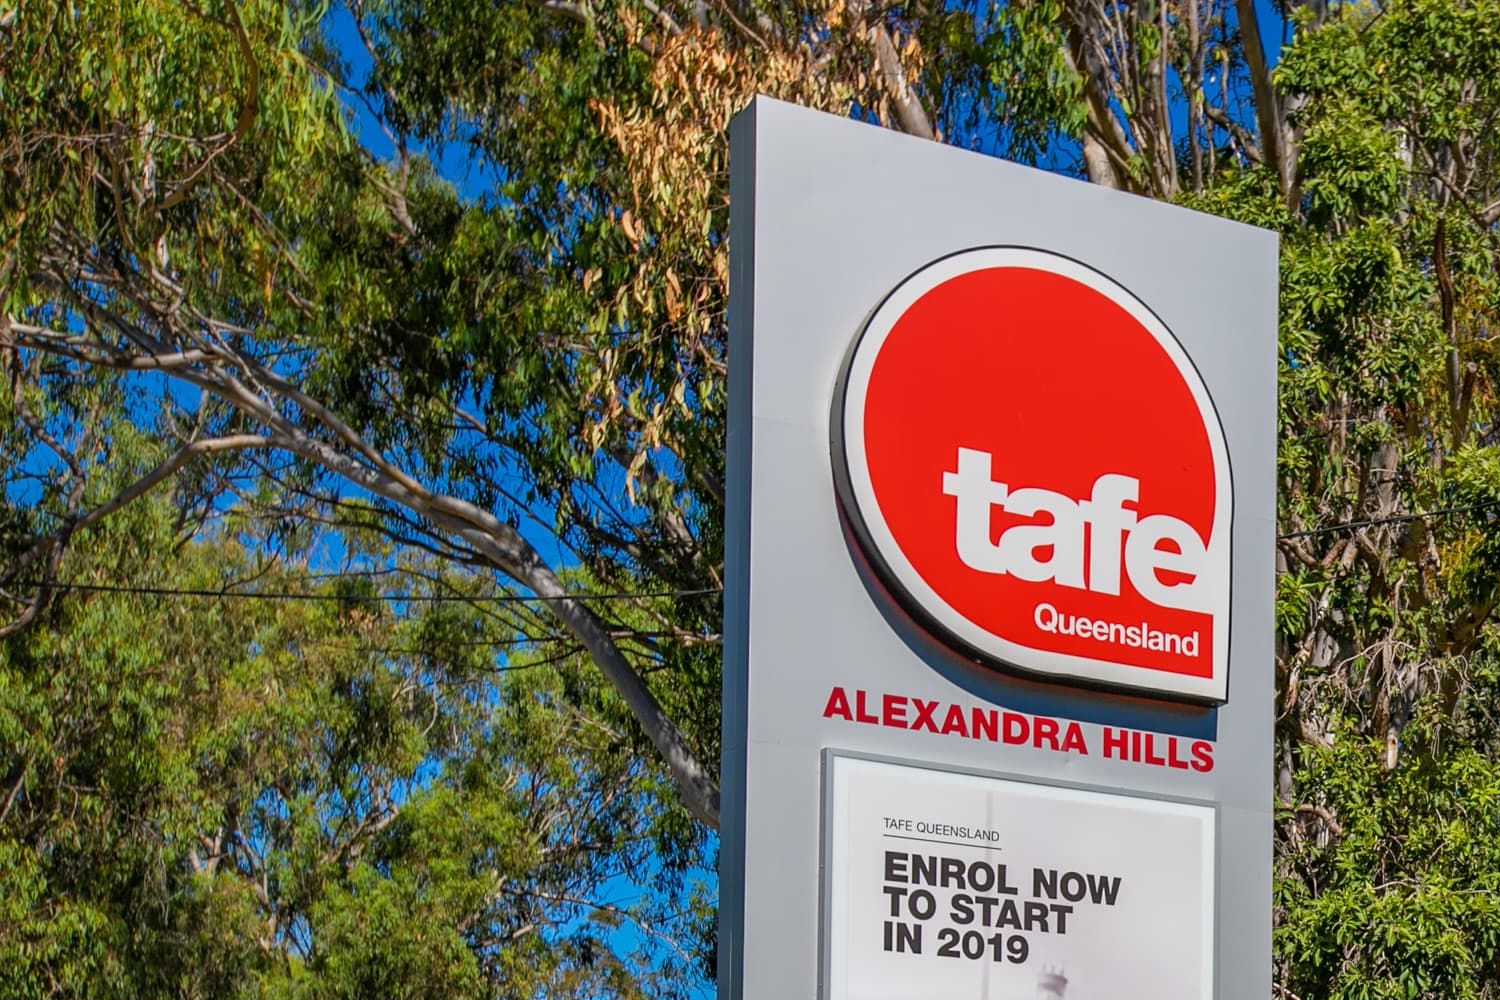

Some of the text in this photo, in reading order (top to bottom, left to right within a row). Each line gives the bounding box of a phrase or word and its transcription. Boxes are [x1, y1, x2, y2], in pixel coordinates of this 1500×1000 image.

[943, 447, 1209, 612] tafe
[1034, 603, 1199, 657] Queensland
[823, 687, 1214, 773] ALEXANDRA HILLS
[883, 817, 1000, 842] TAFE QUEENSLAND
[884, 851, 1121, 905] ENROL NOW
[883, 886, 1073, 934] TO START
[883, 921, 1029, 964] IN 2019
